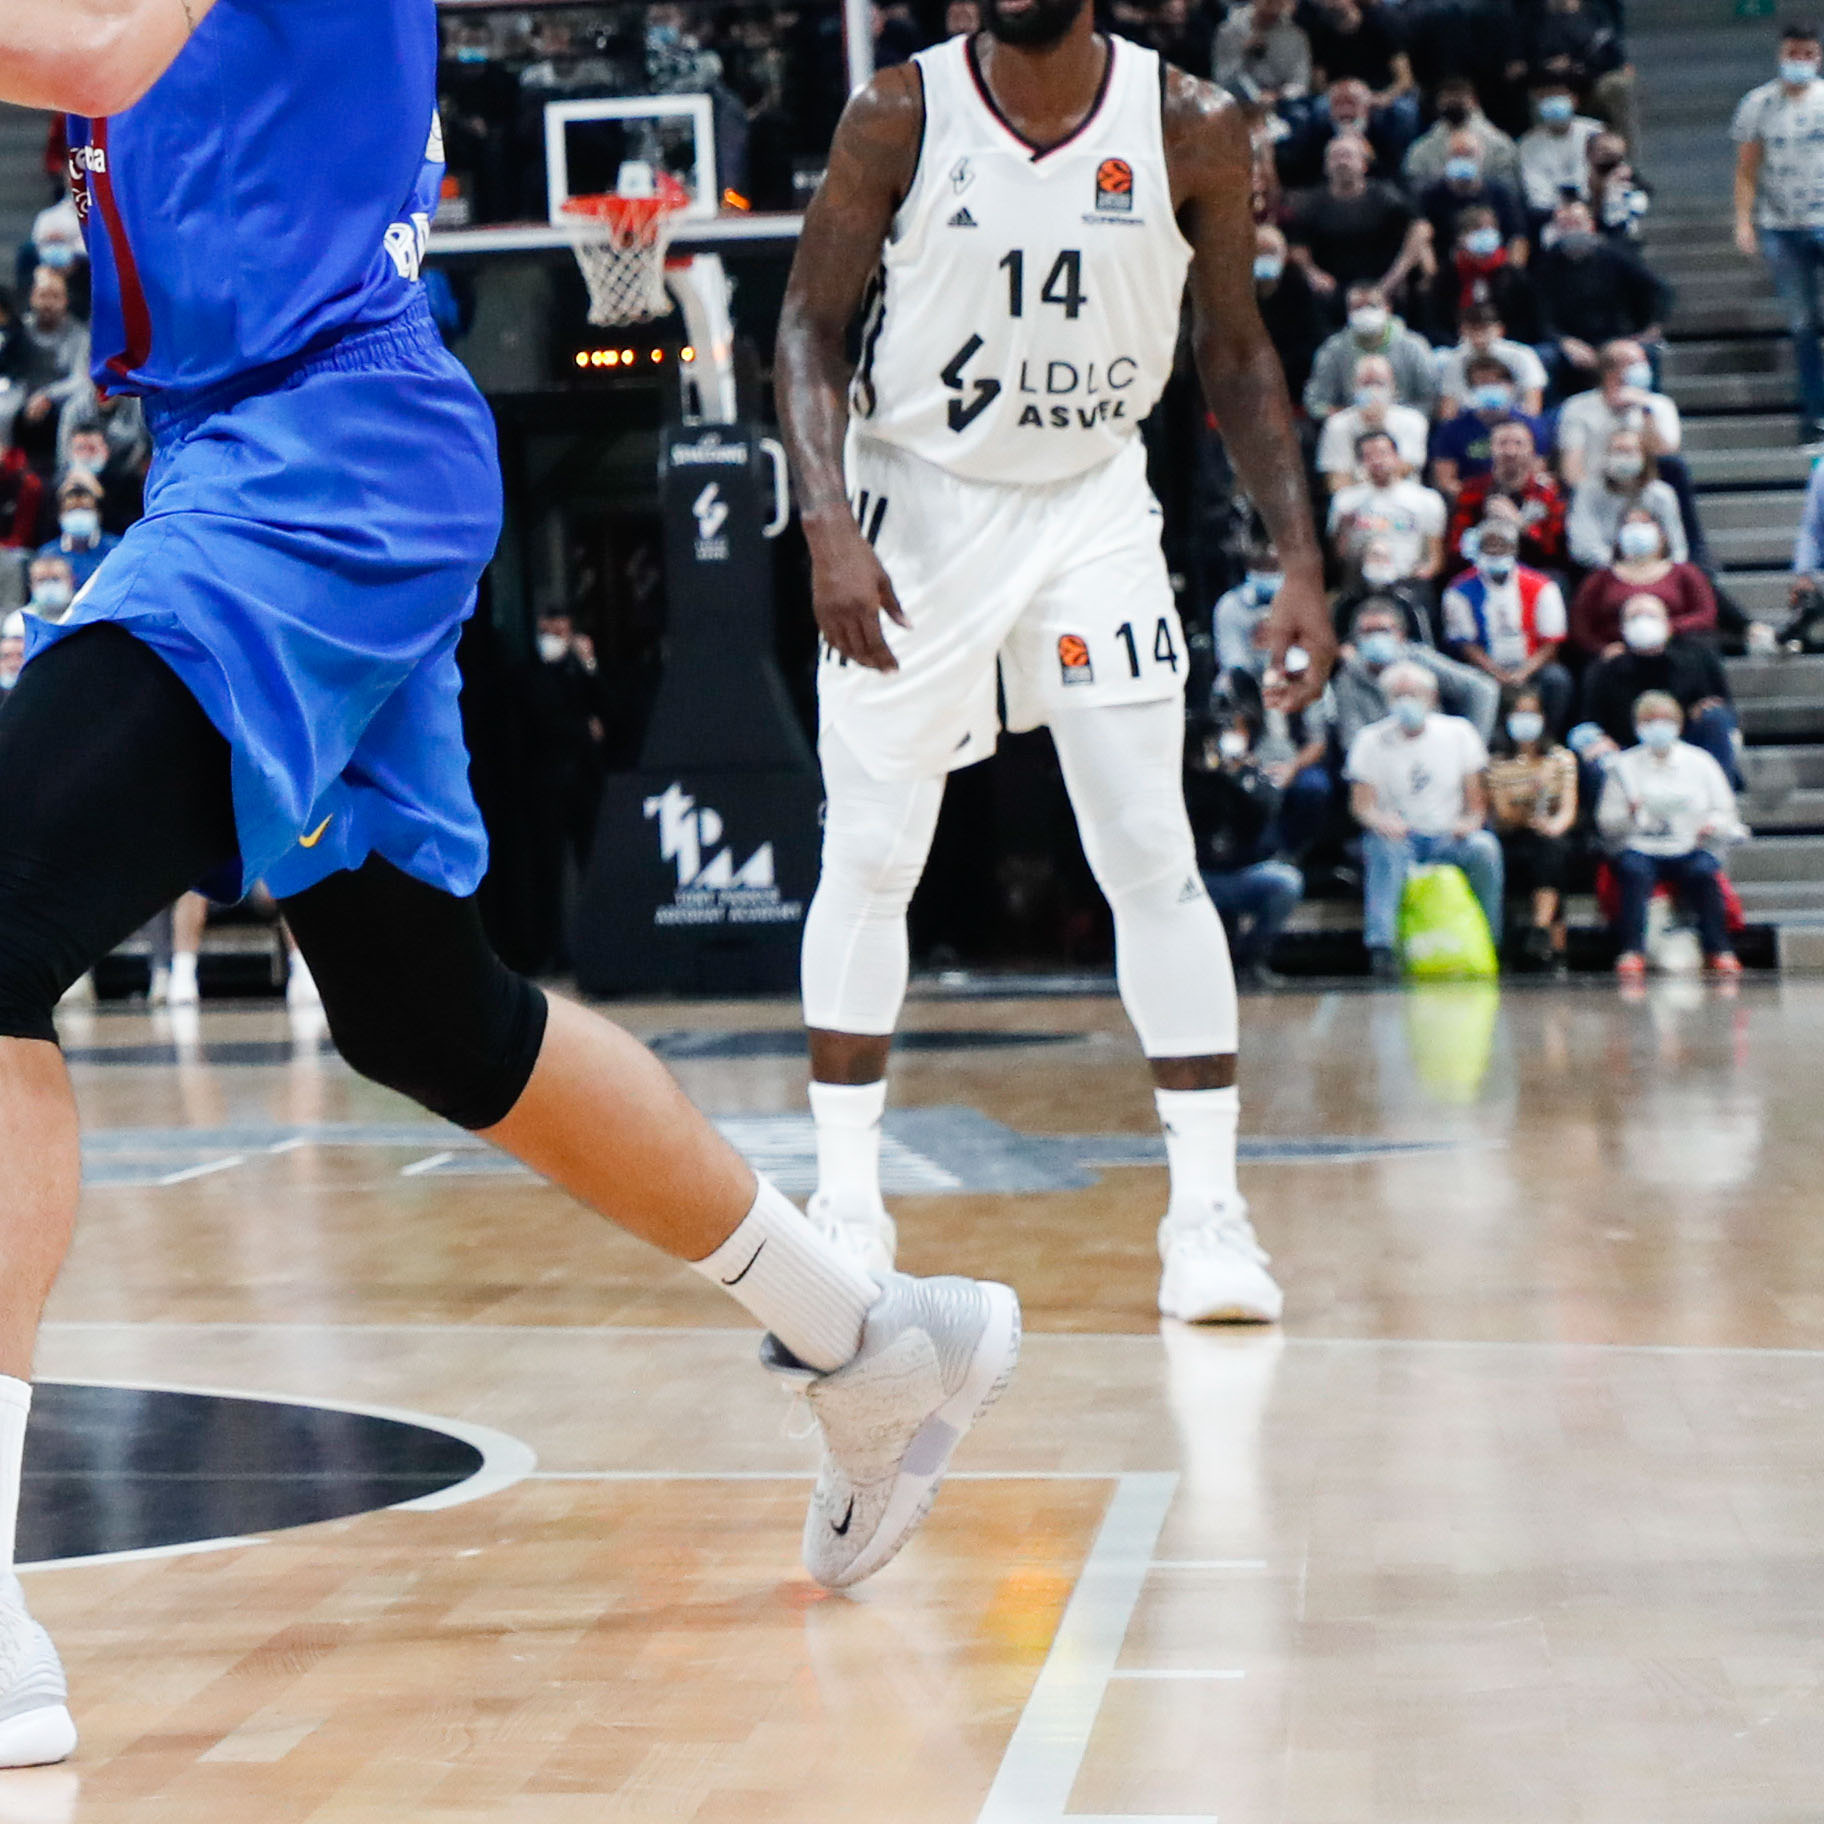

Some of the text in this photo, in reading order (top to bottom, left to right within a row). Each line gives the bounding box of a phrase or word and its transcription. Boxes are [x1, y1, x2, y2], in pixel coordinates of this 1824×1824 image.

[998, 248, 1088, 319] 14
[1019, 356, 1138, 395] LDLC
[1018, 399, 1125, 429] ASVEL
[1115, 617, 1178, 678] 14
